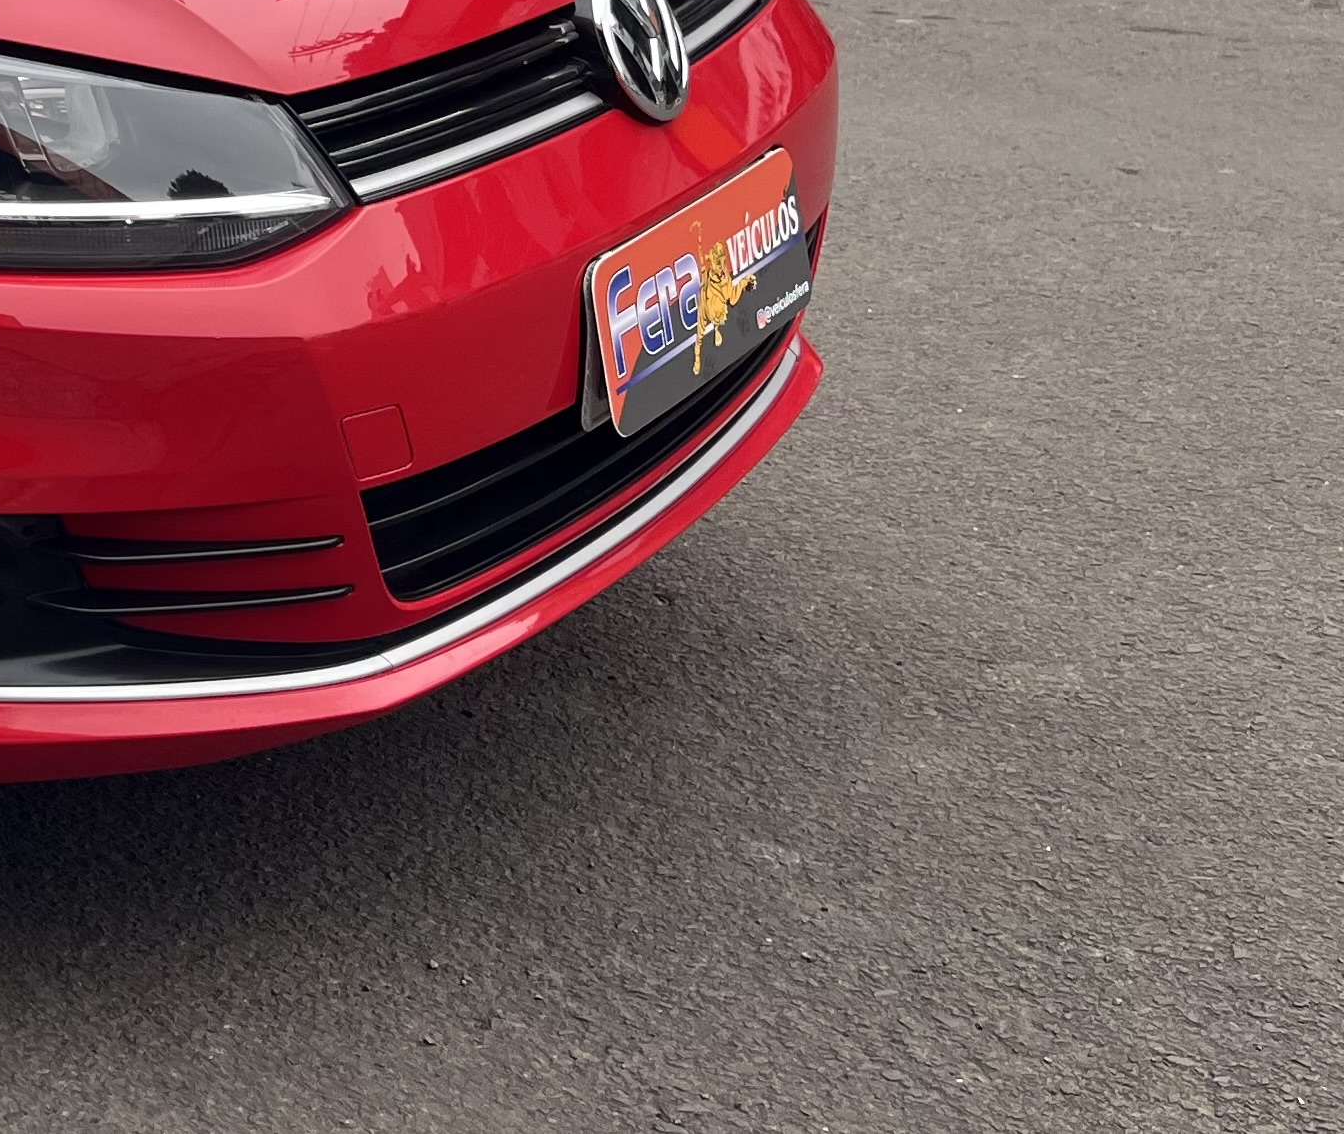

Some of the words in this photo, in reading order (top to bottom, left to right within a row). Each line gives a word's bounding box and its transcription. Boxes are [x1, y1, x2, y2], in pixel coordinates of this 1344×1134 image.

[607, 253, 701, 378] Fera
[725, 195, 799, 277] VEÍCULOS
[764, 280, 810, 324] @veiculosfera
